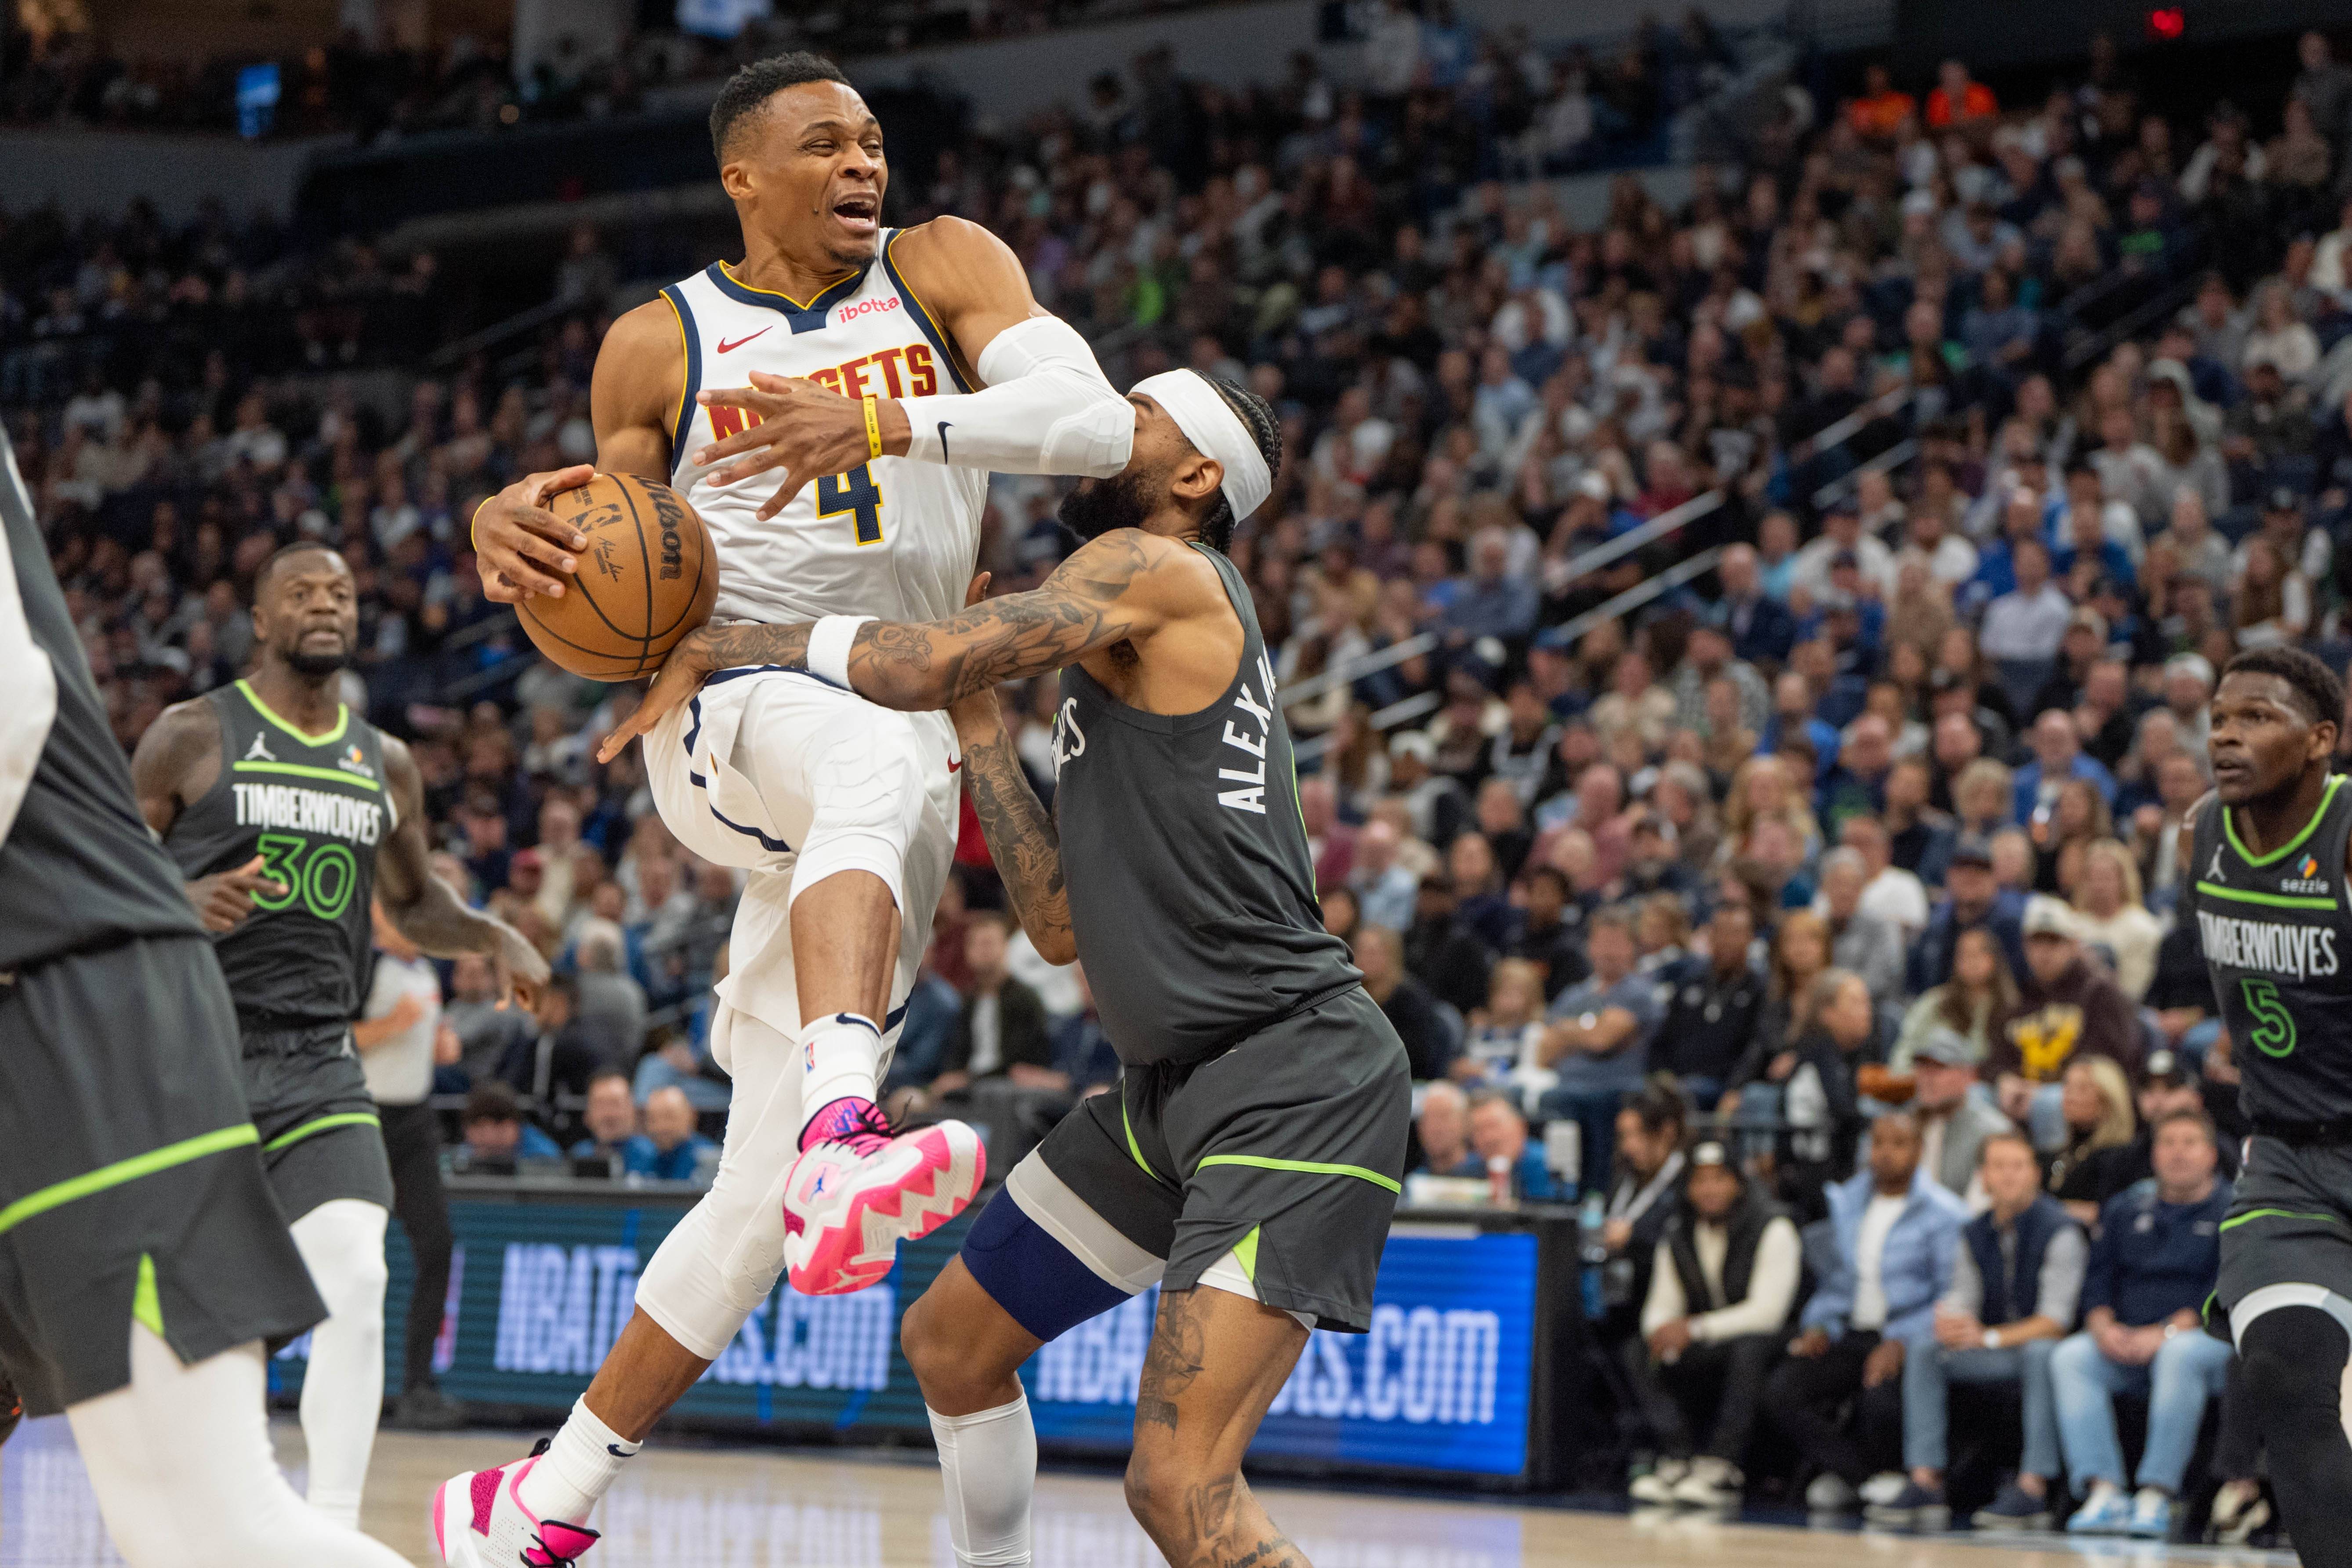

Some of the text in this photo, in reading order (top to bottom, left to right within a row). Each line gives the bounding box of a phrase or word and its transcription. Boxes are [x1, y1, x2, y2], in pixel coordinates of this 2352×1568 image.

[838, 297, 900, 324] ibotta
[704, 343, 938, 441] NETS
[815, 461, 884, 547] 4
[232, 783, 382, 847] TIMBERWOLVES
[249, 833, 357, 920] 30
[2242, 978, 2296, 1058] 5
